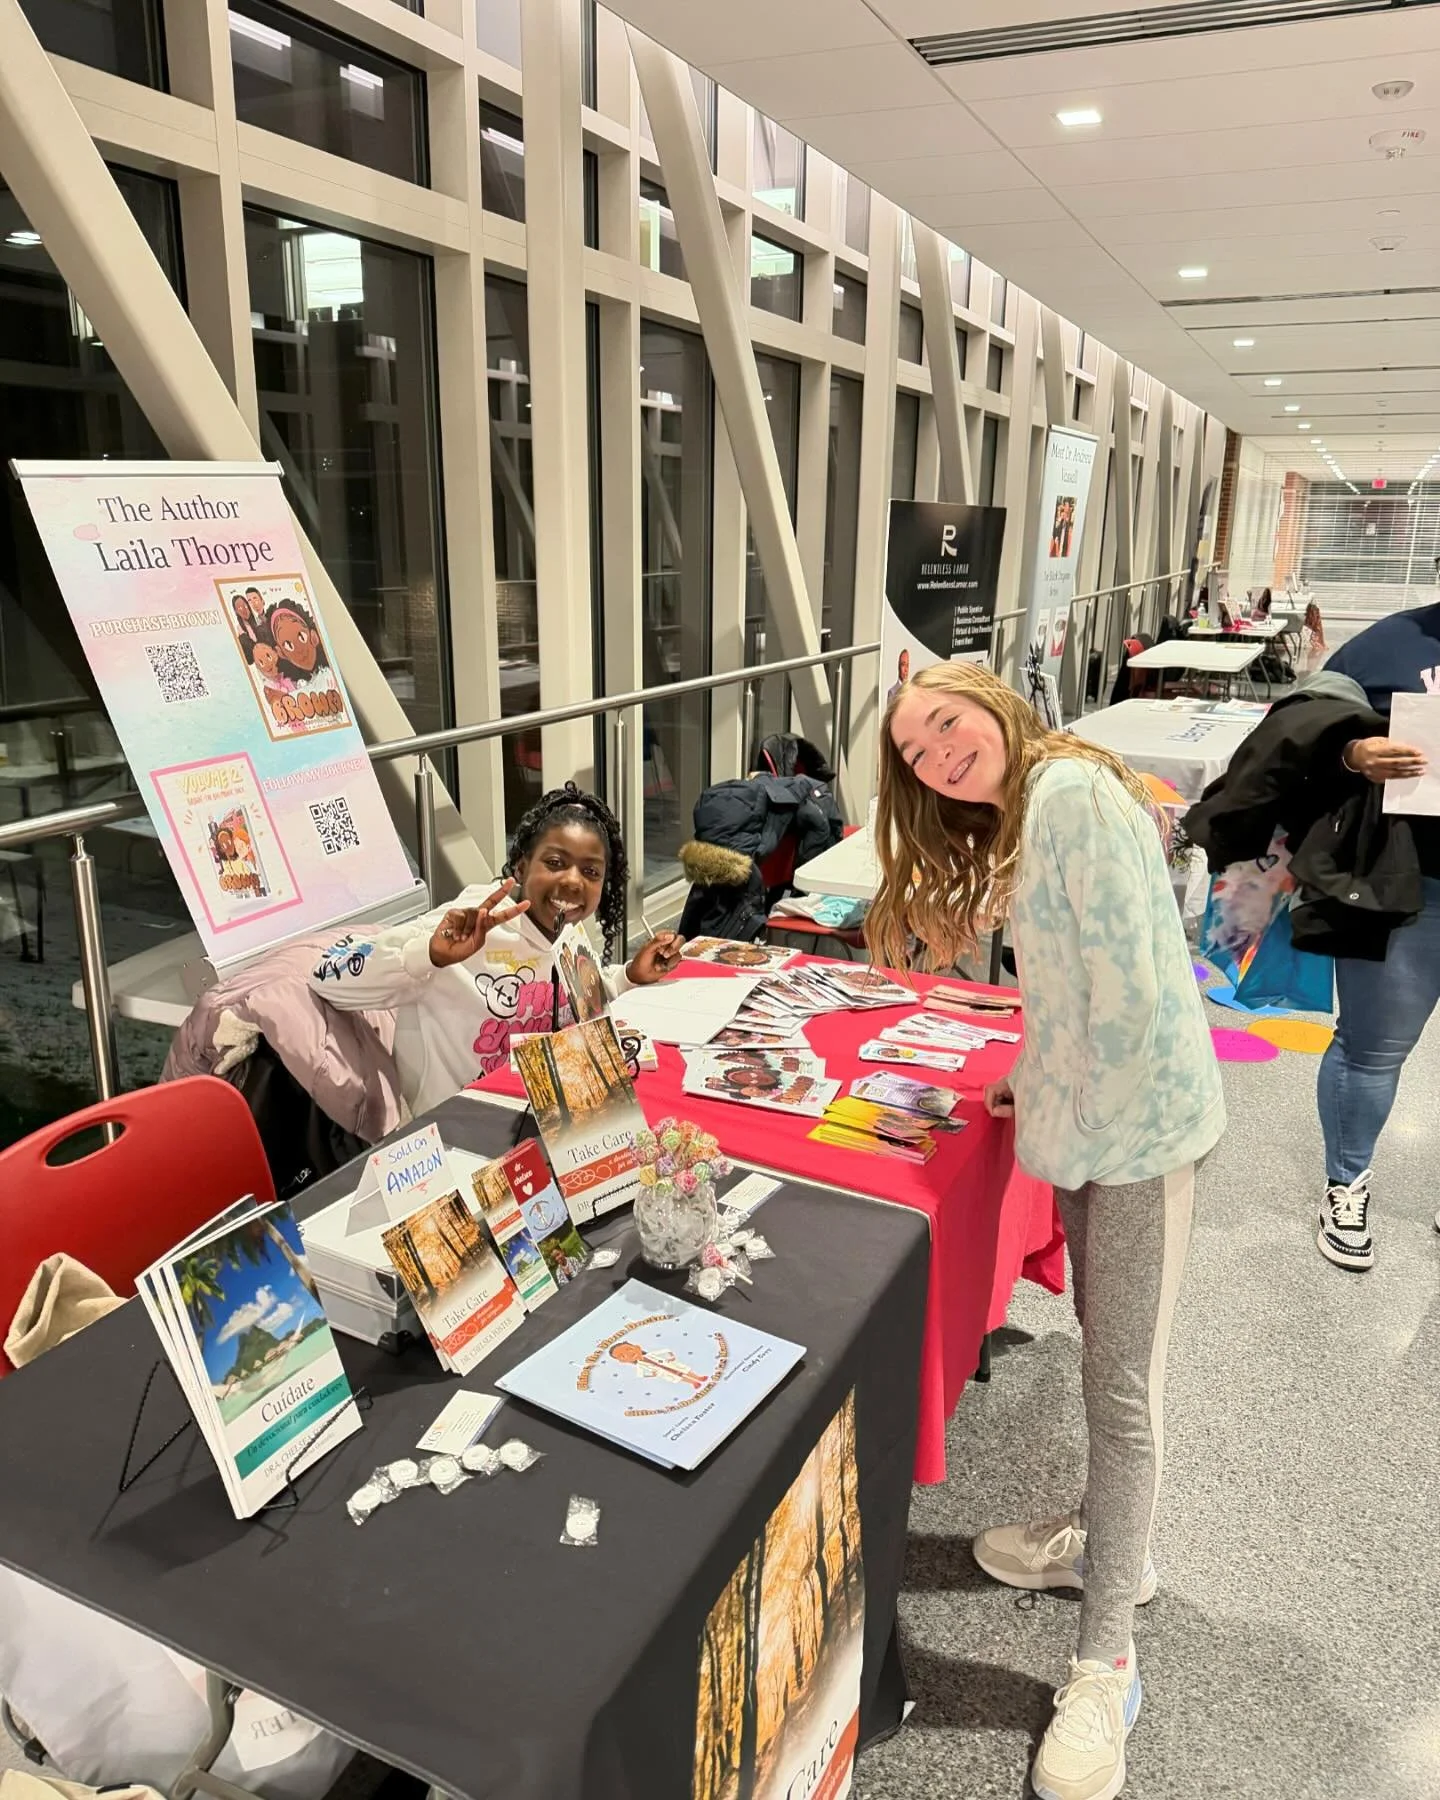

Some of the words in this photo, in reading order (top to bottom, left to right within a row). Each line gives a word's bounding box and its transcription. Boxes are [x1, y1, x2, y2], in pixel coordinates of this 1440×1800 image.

[96, 495, 153, 523] The
[161, 494, 240, 522] Author
[94, 538, 171, 572] Laila
[171, 536, 274, 572] Thorpe
[921, 563, 952, 575] RELENTLESS
[89, 615, 170, 638] PURCHASE
[168, 609, 222, 630] BROWN
[387, 1142, 412, 1164] Sold
[567, 1144, 600, 1164] Take
[601, 1130, 632, 1151] Care
[386, 1147, 442, 1195] AMAZON
[442, 1307, 468, 1329] Take
[465, 1288, 489, 1311] Care
[261, 1377, 316, 1423] Cuídate
[786, 1720, 837, 1800] Care
